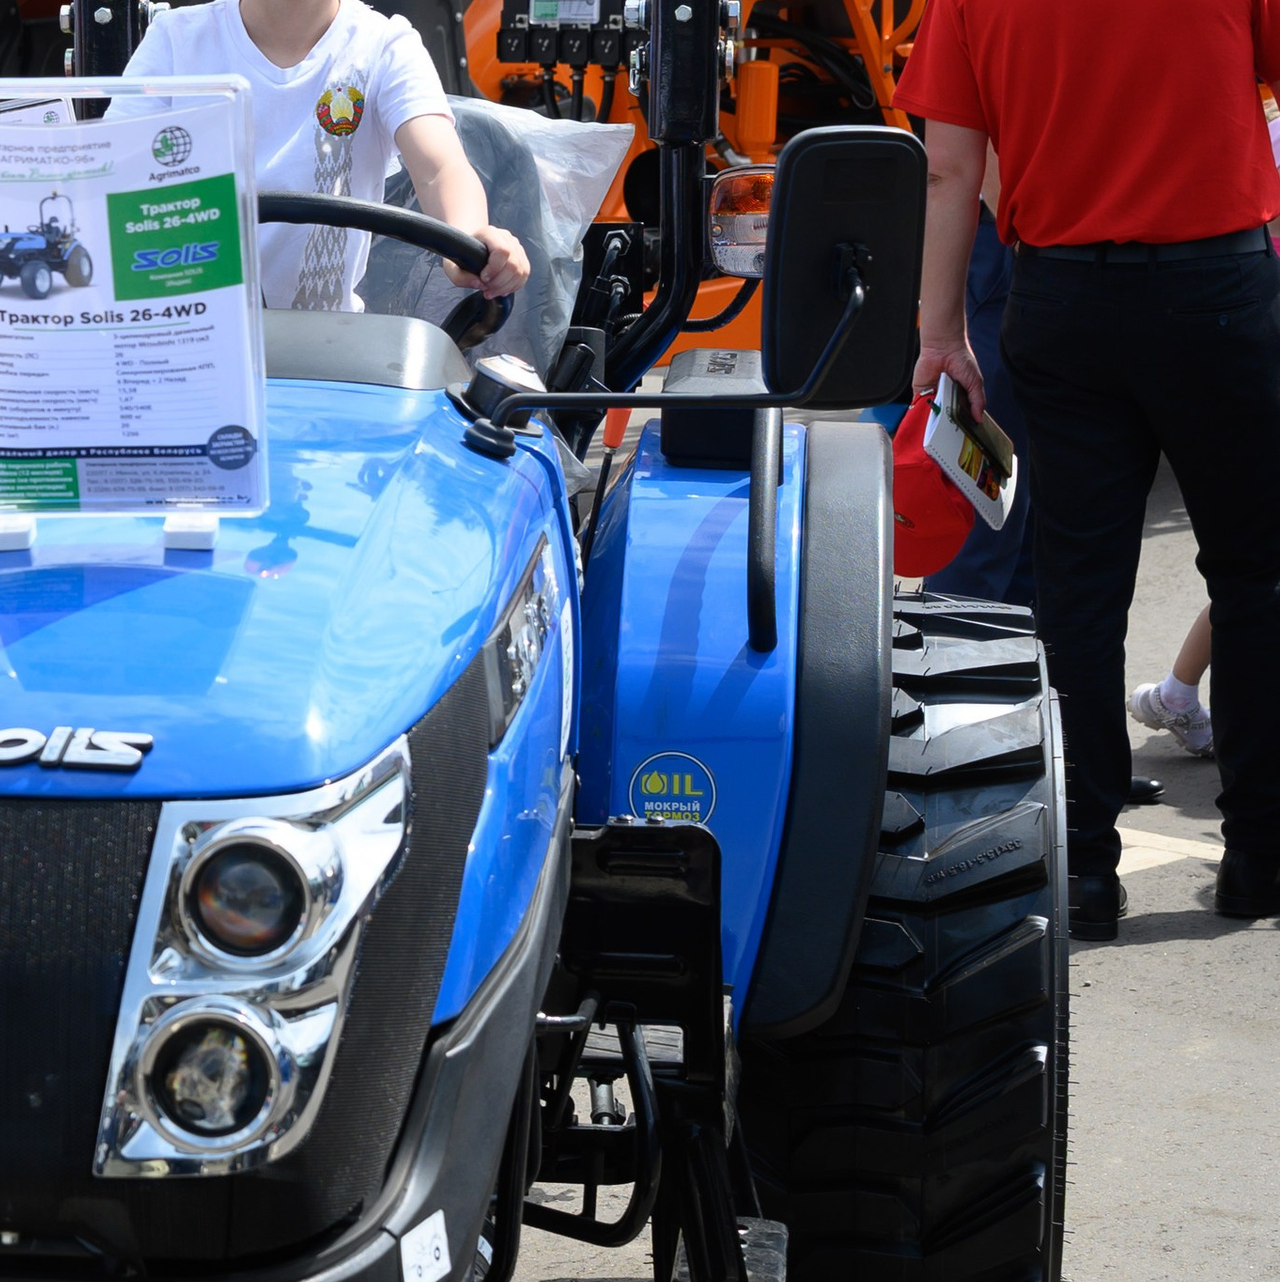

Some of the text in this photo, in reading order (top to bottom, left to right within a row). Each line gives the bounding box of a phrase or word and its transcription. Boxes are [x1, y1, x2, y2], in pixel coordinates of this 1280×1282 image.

[148, 166, 201, 182] Agrimatco
[140, 198, 201, 217] Трактор
[125, 208, 221, 234] Solis 26-4WD
[80, 310, 124, 325] Solis
[130, 302, 207, 322] 26-4WD
[641, 770, 703, 795] OIL
[644, 800, 701, 811] МОКРЫЙ
